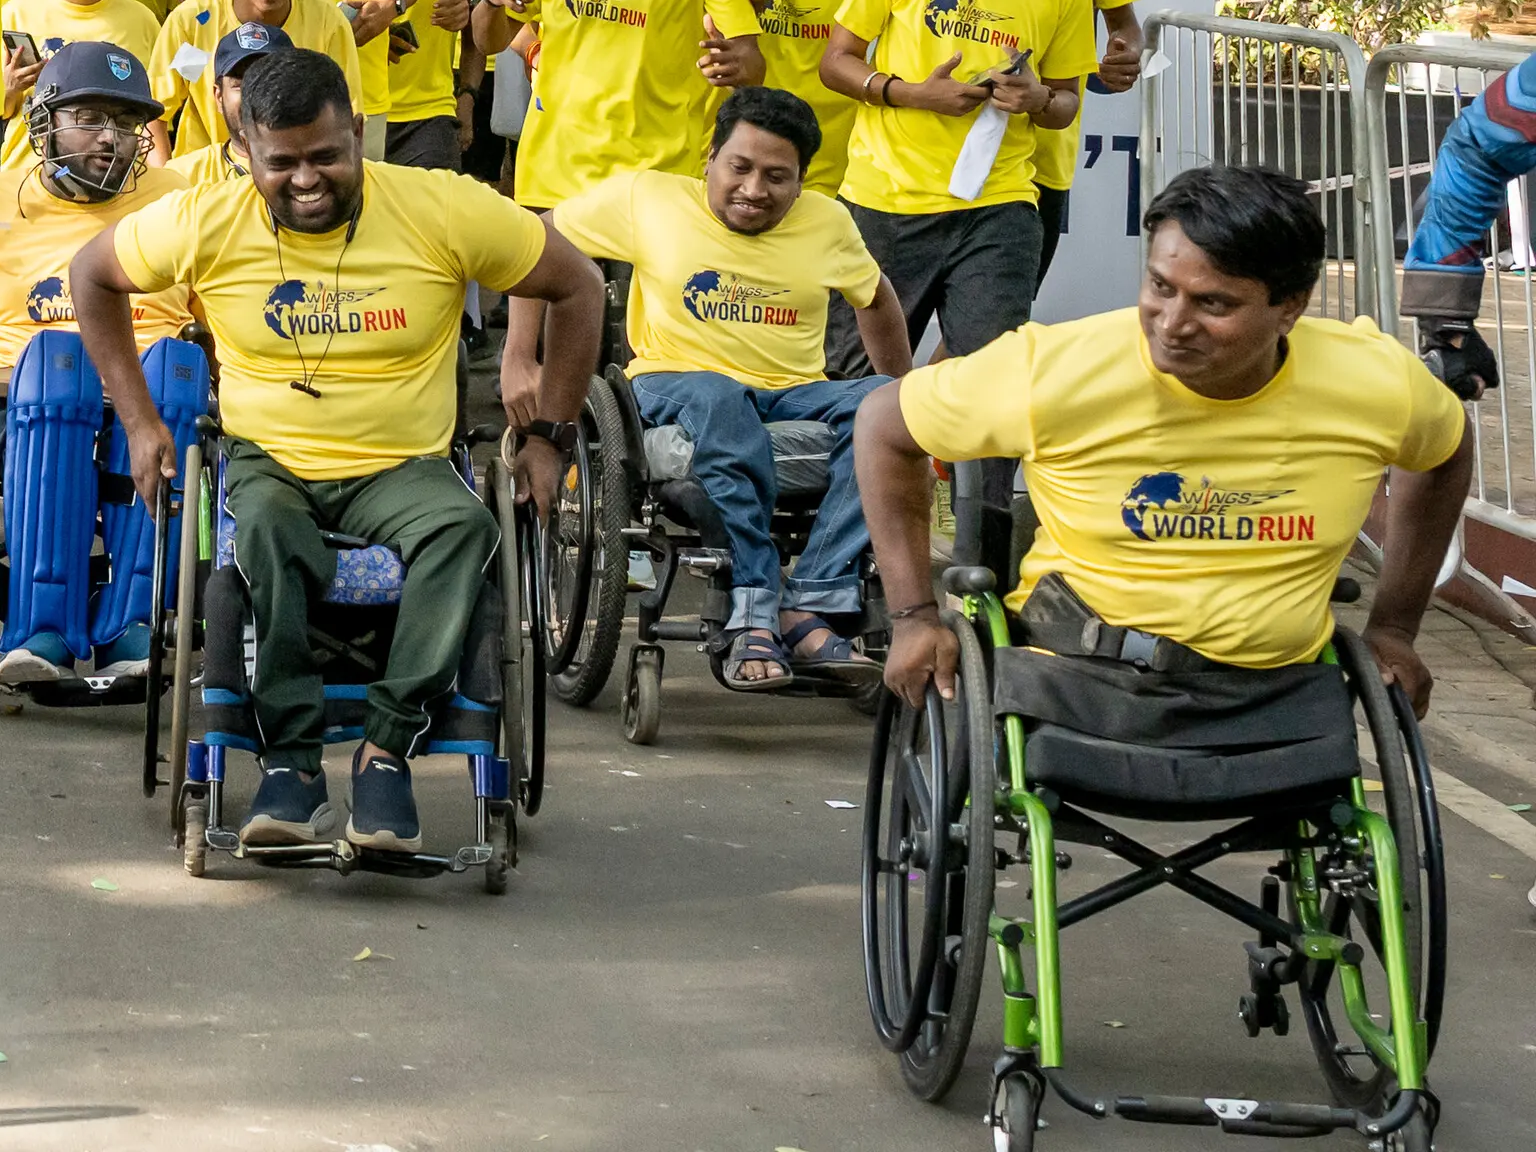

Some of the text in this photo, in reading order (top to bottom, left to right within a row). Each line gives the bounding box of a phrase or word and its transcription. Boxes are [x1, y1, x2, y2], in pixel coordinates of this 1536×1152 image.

[576, 0, 647, 28] WORLD RUN
[801, 24, 830, 39] RUN
[941, 19, 1019, 48] WORLD RUN
[305, 291, 355, 303] WINGS
[719, 284, 763, 297] WINGS
[288, 308, 407, 335] WORLD RUN
[702, 301, 799, 326] WORLD RUN
[1182, 490, 1252, 505] WINGS
[1153, 515, 1314, 542] WORLD RUN
